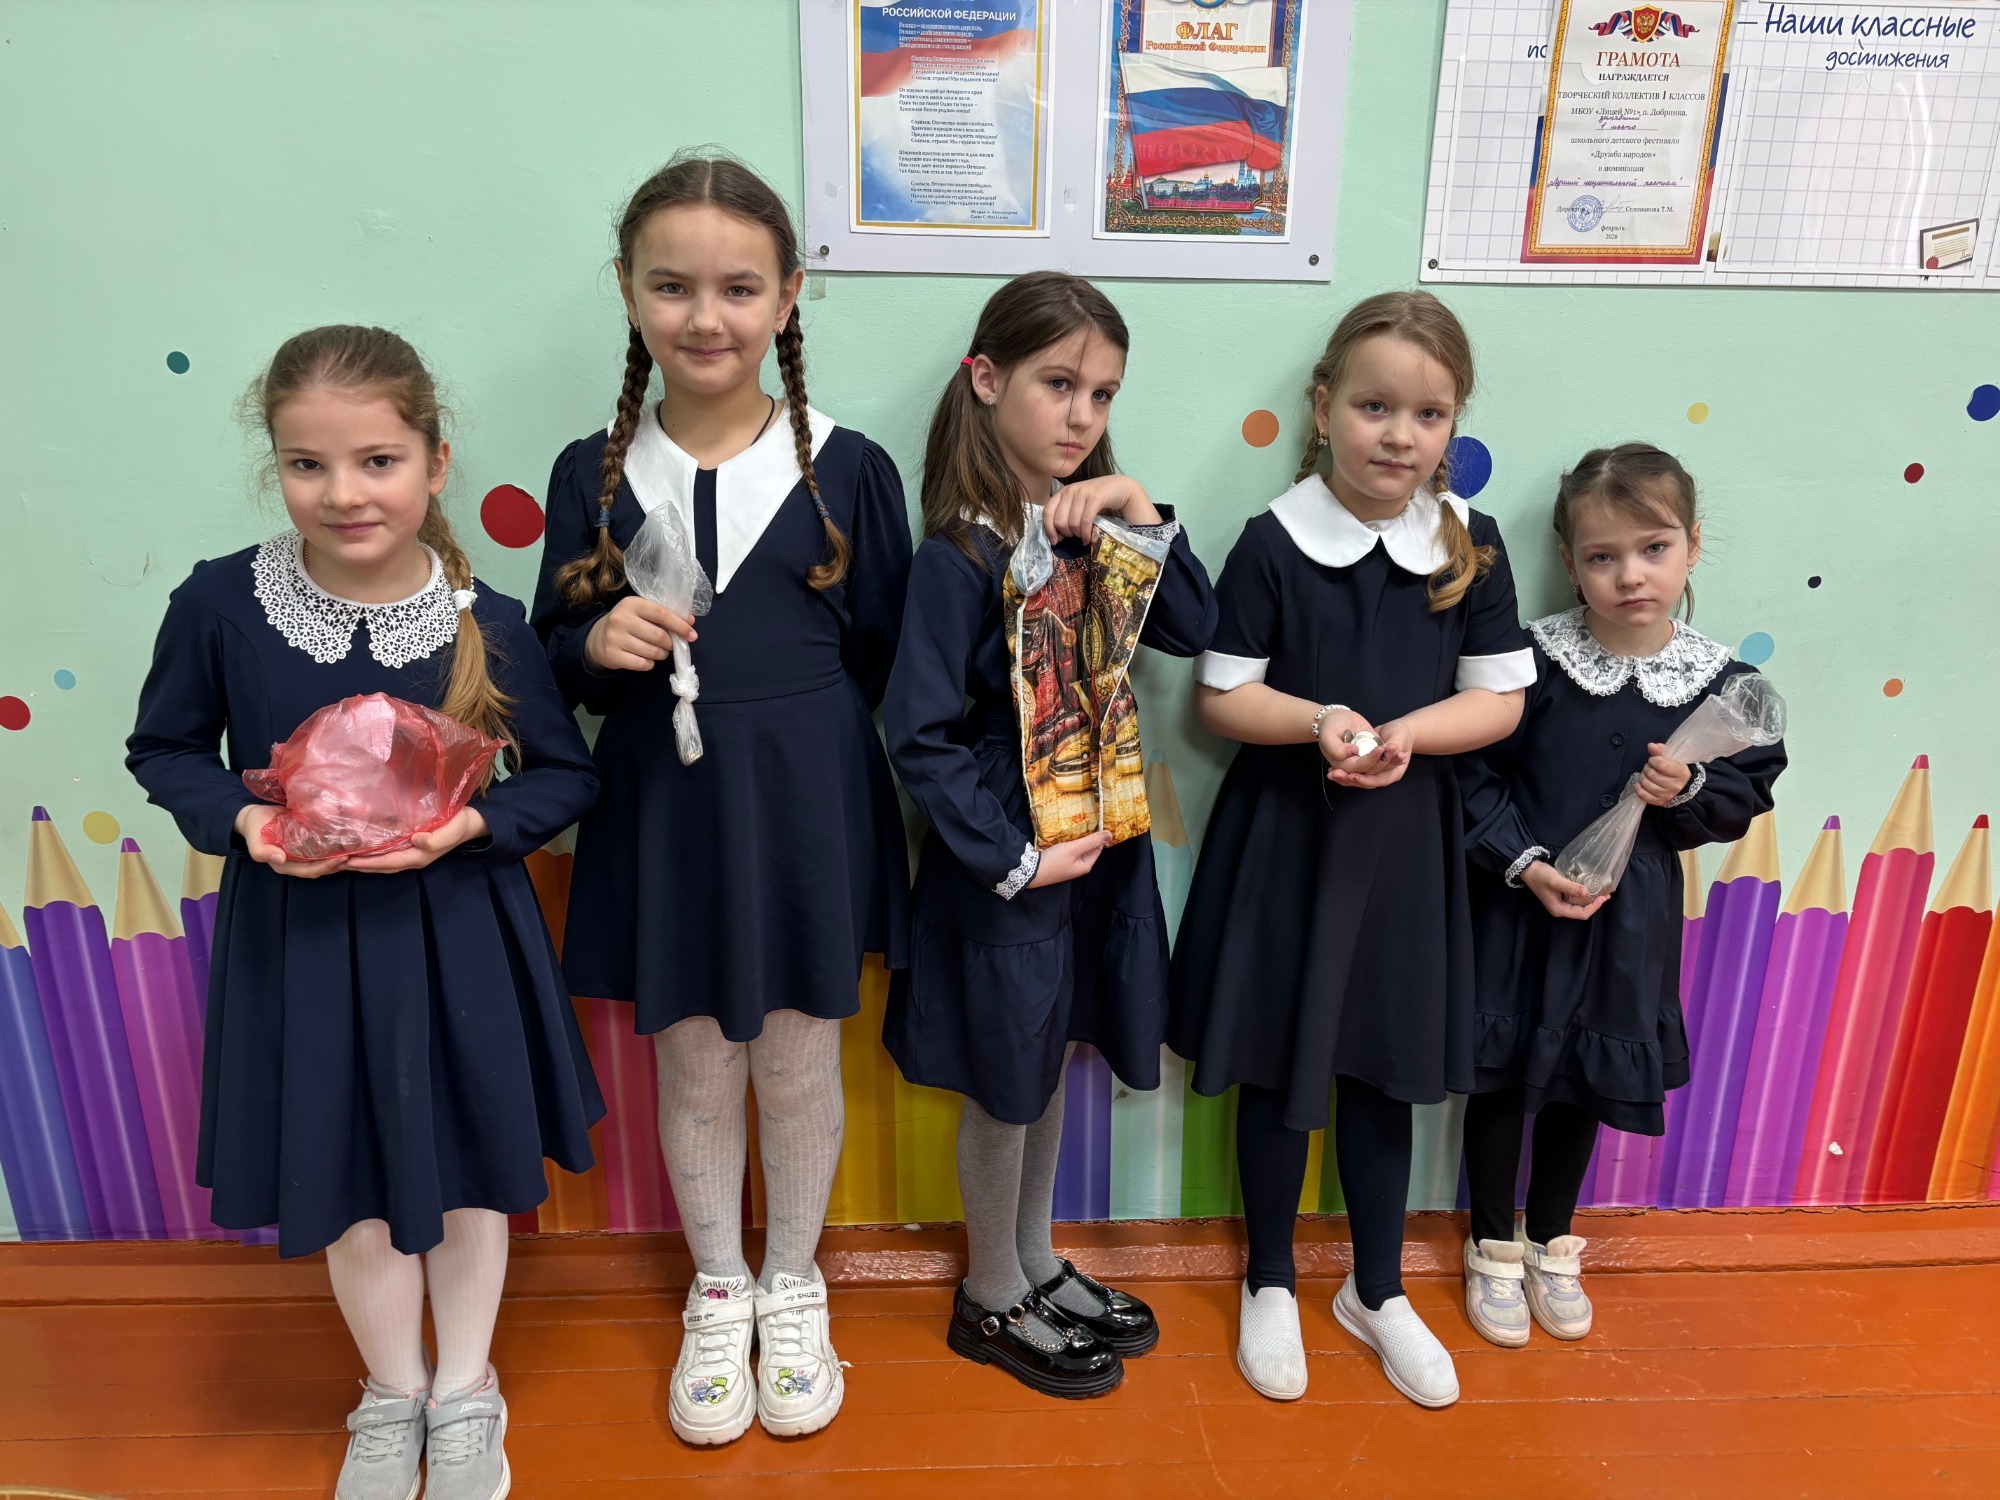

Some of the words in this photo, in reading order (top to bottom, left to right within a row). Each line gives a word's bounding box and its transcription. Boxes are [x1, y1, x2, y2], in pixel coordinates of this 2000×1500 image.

[882, 6, 952, 19] РОССИЙСКОЙ
[953, 10, 1016, 22] ФЕДЕРАЦИИ
[1765, 3, 1844, 36] Наши
[1852, 14, 1976, 38] классные
[1176, 21, 1238, 40] ФЛАГ
[1145, 40, 1206, 51] Российской
[1208, 42, 1266, 54] Федерации
[1596, 51, 1680, 68] ГРАМОТА
[1826, 51, 1950, 70] достижения
[1598, 73, 1669, 82] НАГРАЖДАЕТСЯ
[1558, 90, 1610, 100] ТВОРЧЕСКИЙ
[1612, 91, 1660, 100] КОЛЛЕКТИВ
[1669, 93, 1706, 101] КЛАССОВ
[1571, 107, 1594, 115] МБОУ
[1570, 137, 1609, 145] школьного
